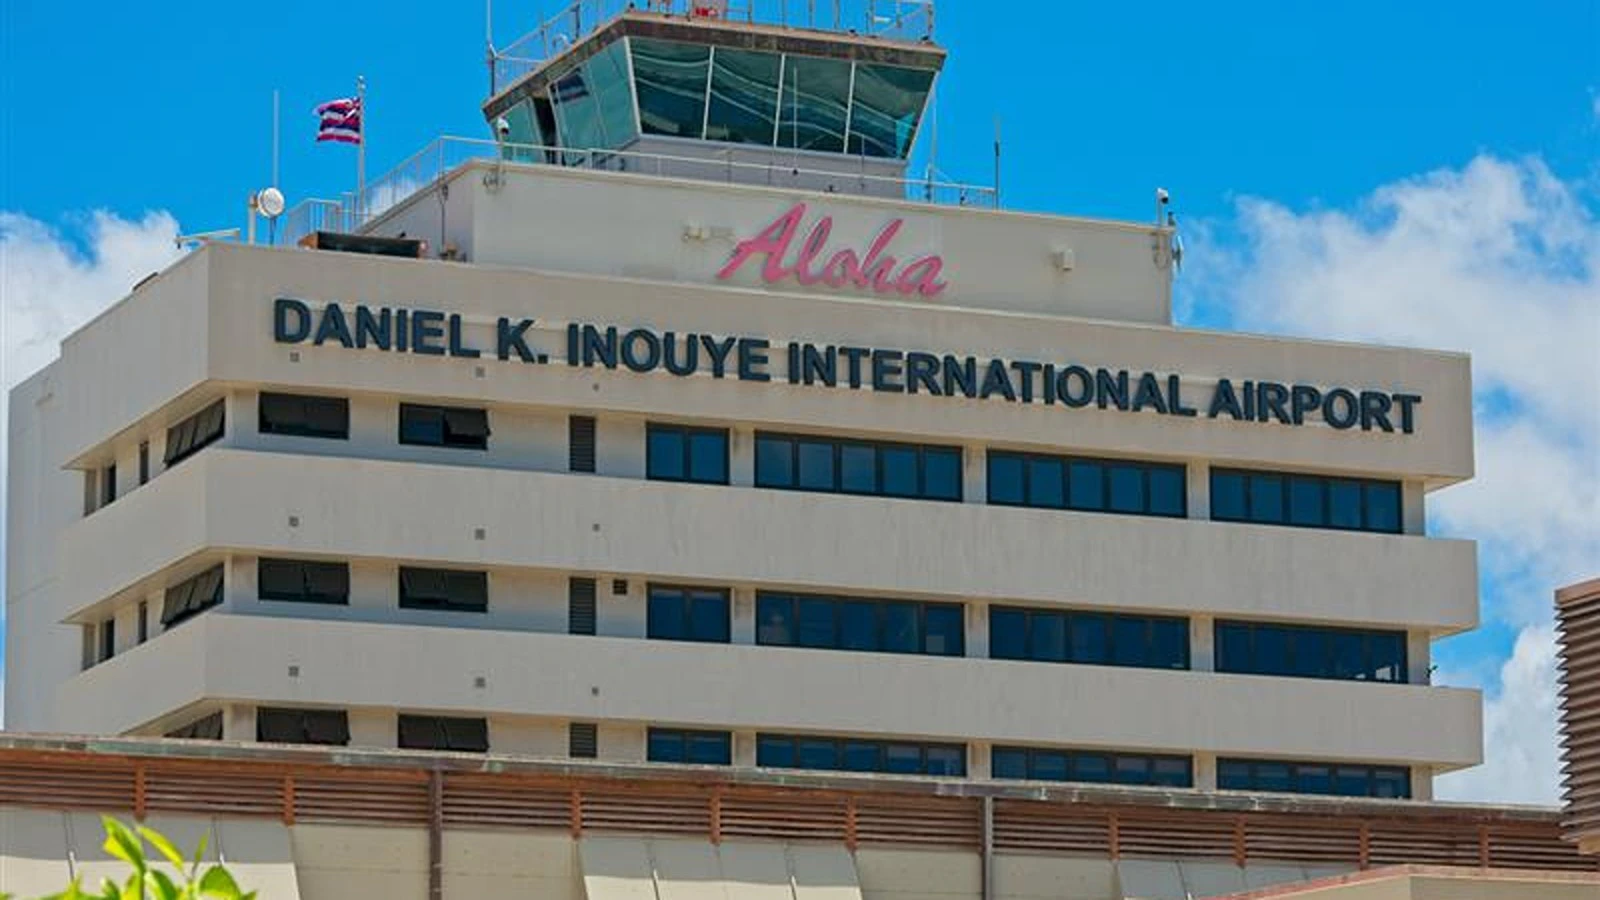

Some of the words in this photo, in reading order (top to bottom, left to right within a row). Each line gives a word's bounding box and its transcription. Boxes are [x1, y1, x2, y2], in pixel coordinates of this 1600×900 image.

[717, 202, 948, 298] Aloha
[273, 298, 481, 359] DANIEL
[496, 317, 549, 365] K.
[567, 322, 770, 382] INOUYE
[786, 342, 1197, 417] INTERNATIONAL
[1208, 378, 1422, 434] AIRPORT
